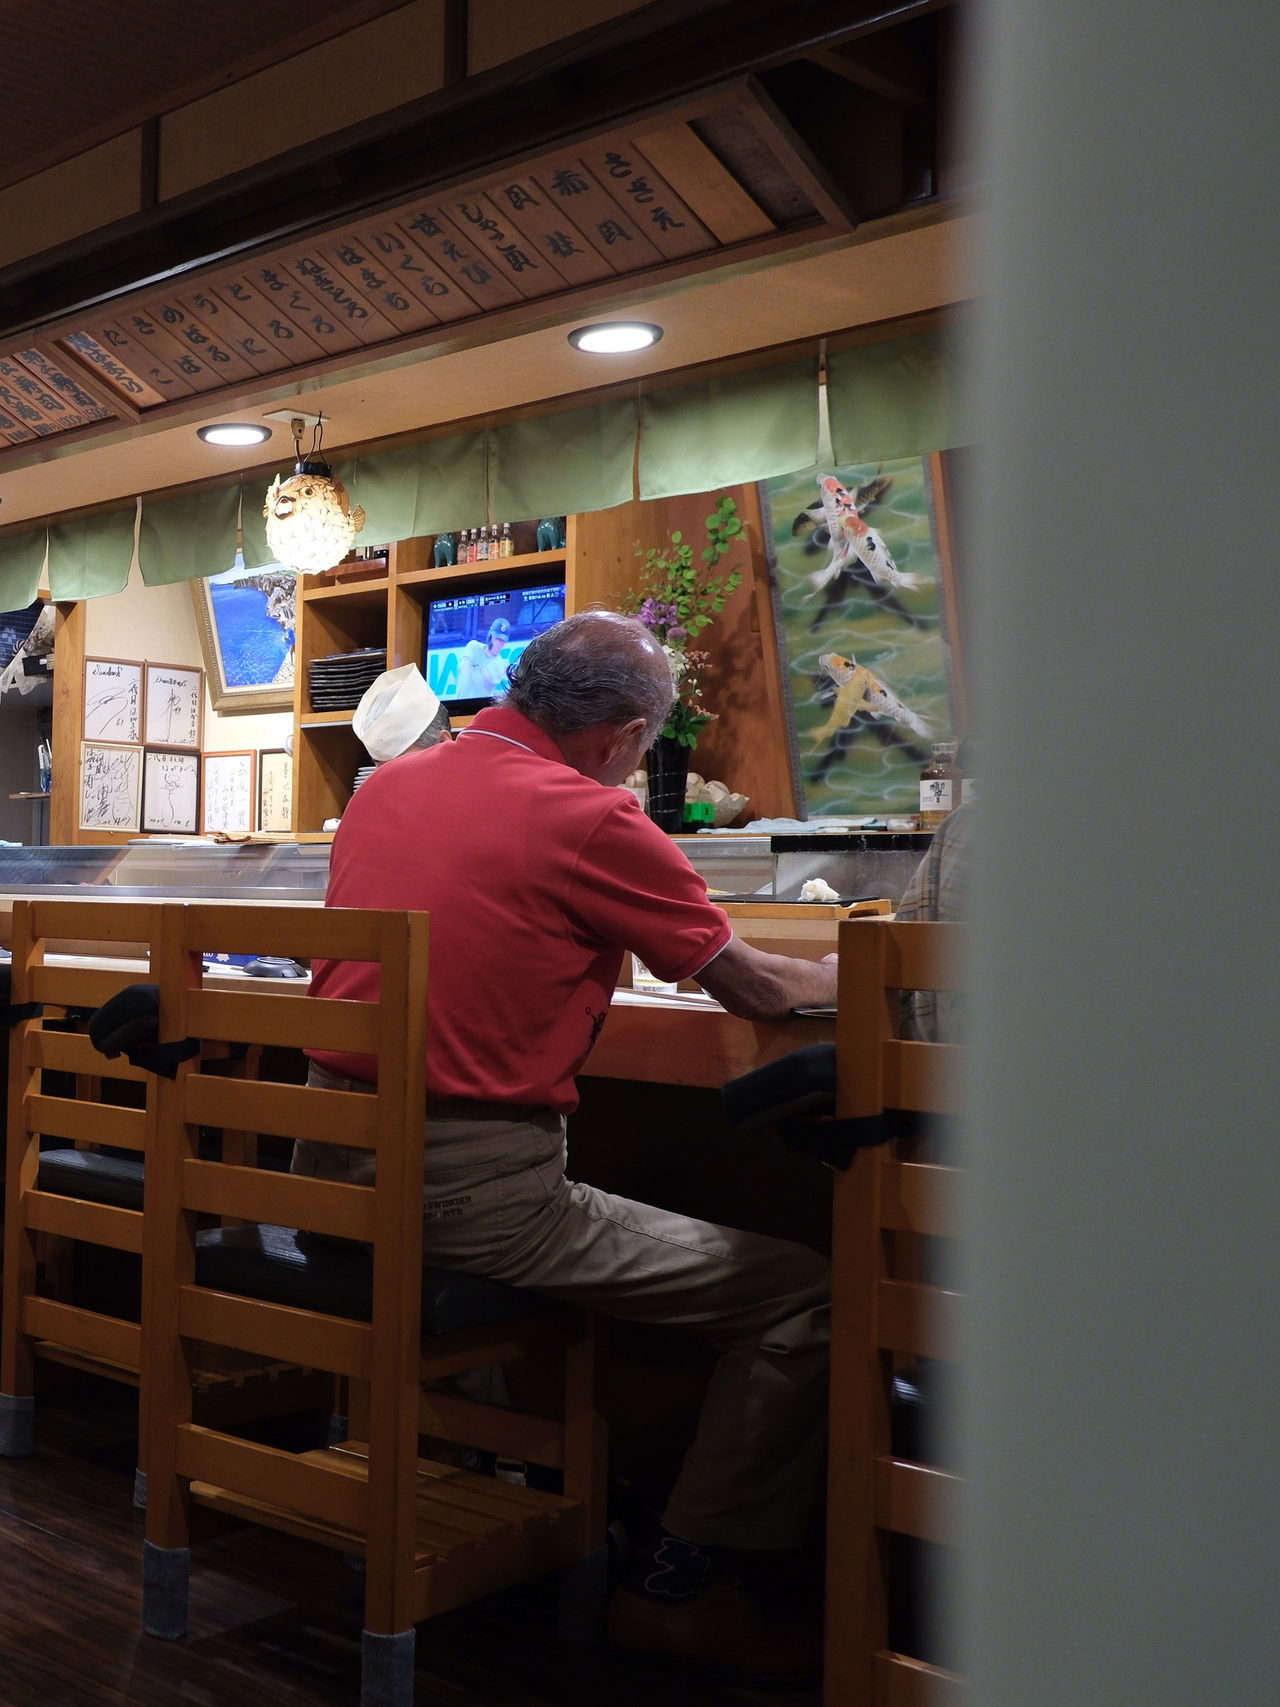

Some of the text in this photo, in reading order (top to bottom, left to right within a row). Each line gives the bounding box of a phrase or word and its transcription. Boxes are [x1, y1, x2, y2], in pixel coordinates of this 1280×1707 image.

[551, 169, 633, 246] 赤貝
[335, 245, 410, 310] はまち
[371, 232, 449, 296] いくら
[192, 293, 267, 356] うに
[225, 283, 294, 339] とろ
[261, 268, 335, 334] まぐろ
[102, 328, 174, 384] たこ
[131, 316, 202, 375] さば
[160, 304, 230, 363] めばる
[427, 1195, 472, 1210] SWINGER
